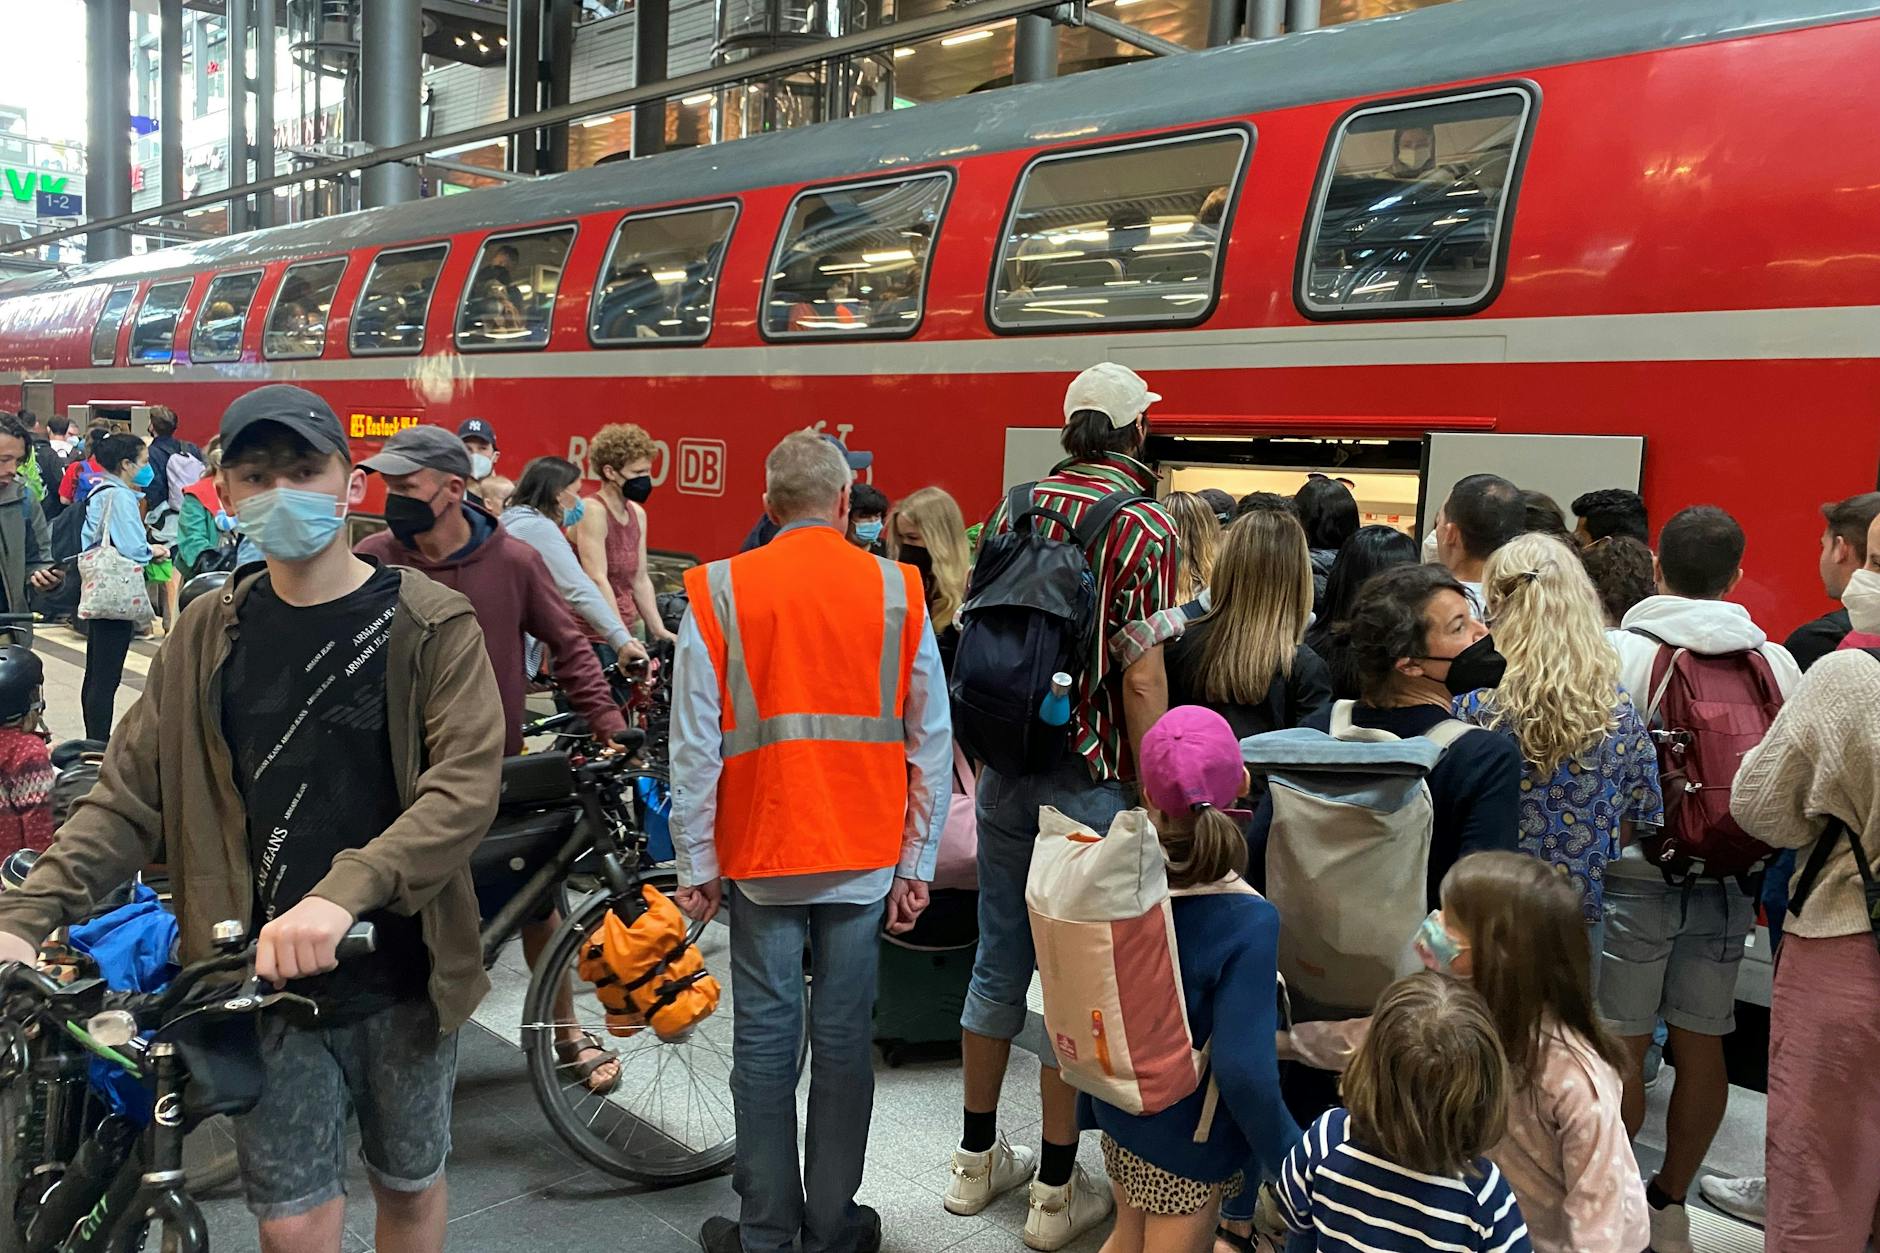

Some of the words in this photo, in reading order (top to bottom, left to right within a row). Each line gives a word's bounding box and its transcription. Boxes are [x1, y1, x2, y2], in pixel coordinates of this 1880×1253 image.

[0, 168, 69, 203] VK
[46, 194, 70, 209] 1-2
[688, 446, 718, 486] DB
[352, 618, 384, 647] ARMANI
[344, 645, 376, 677] ARMANI
[262, 826, 289, 871] JEANS
